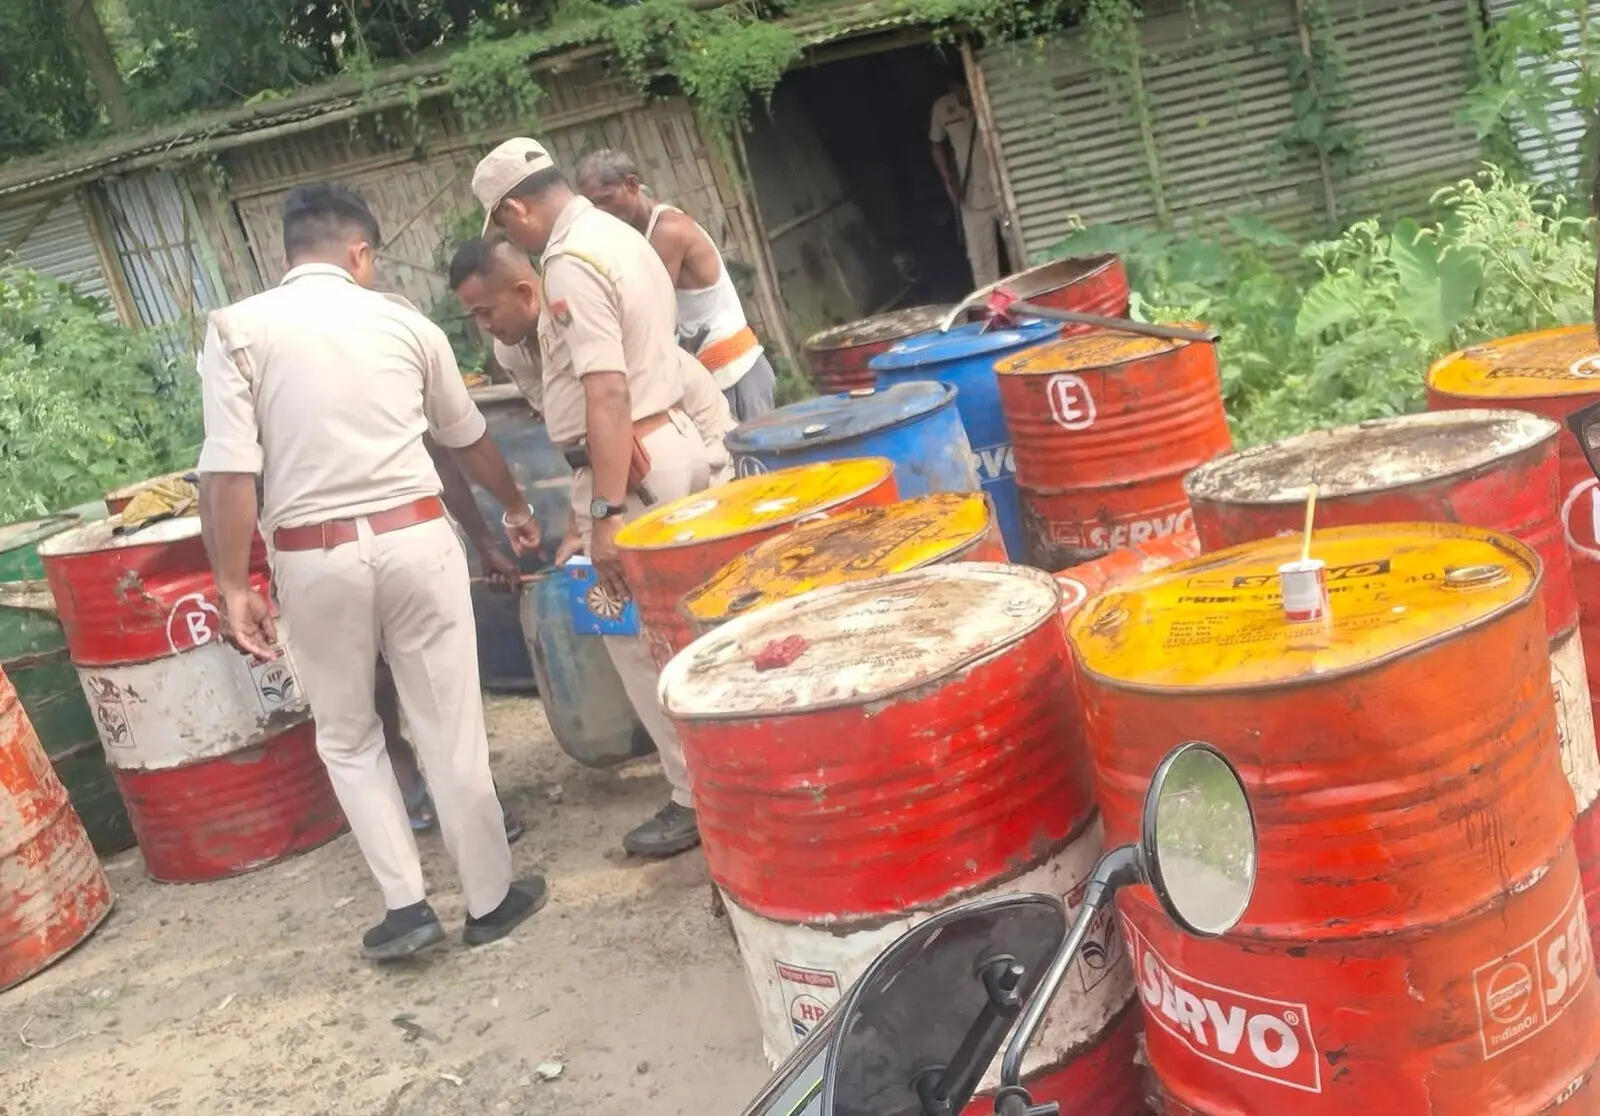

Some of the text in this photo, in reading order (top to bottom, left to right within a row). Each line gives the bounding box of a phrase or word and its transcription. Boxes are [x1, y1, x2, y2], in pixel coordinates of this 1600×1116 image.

[1056, 380, 1083, 421] E
[186, 611, 212, 646] B
[799, 1003, 826, 1022] HP
[1490, 1012, 1539, 1046] IndianOil
